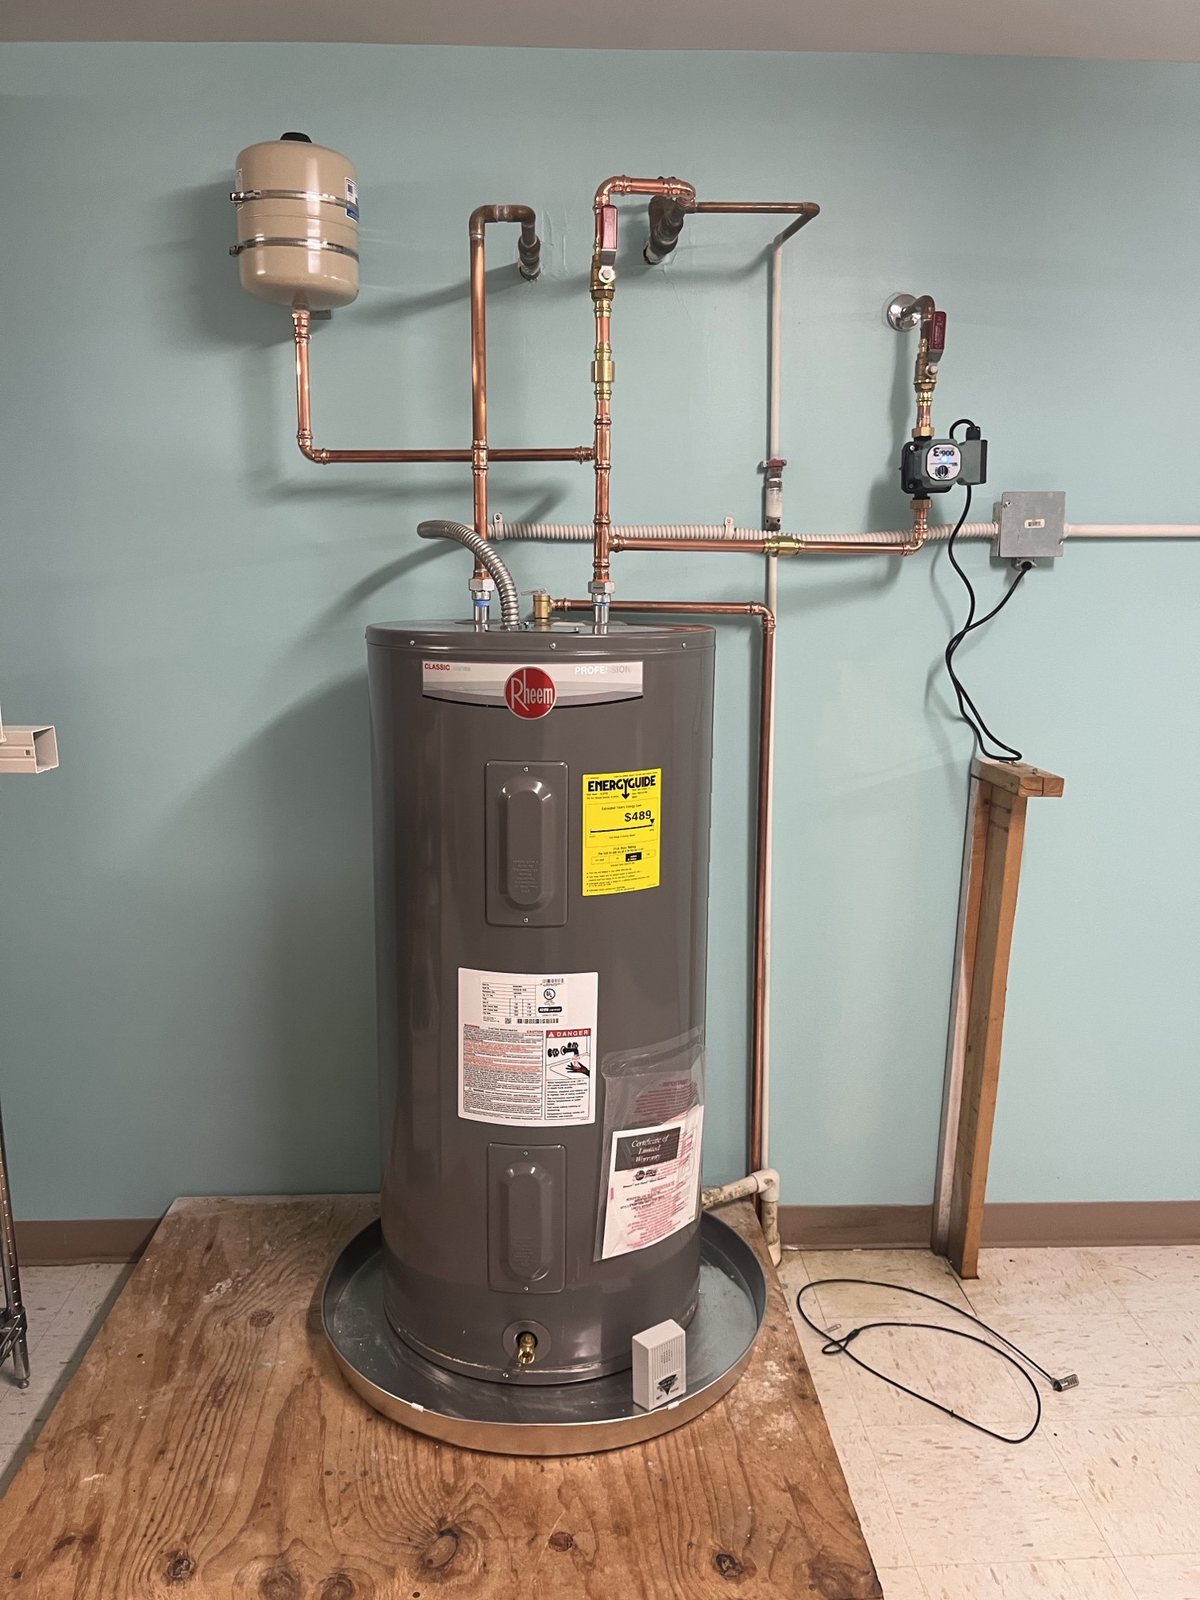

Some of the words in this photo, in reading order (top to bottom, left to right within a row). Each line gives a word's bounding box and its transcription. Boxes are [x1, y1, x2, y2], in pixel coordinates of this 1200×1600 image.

[424, 663, 450, 671] CLASSIC
[510, 669, 553, 711] Rheem
[624, 810, 652, 822] $489
[556, 1029, 589, 1037] DANGER
